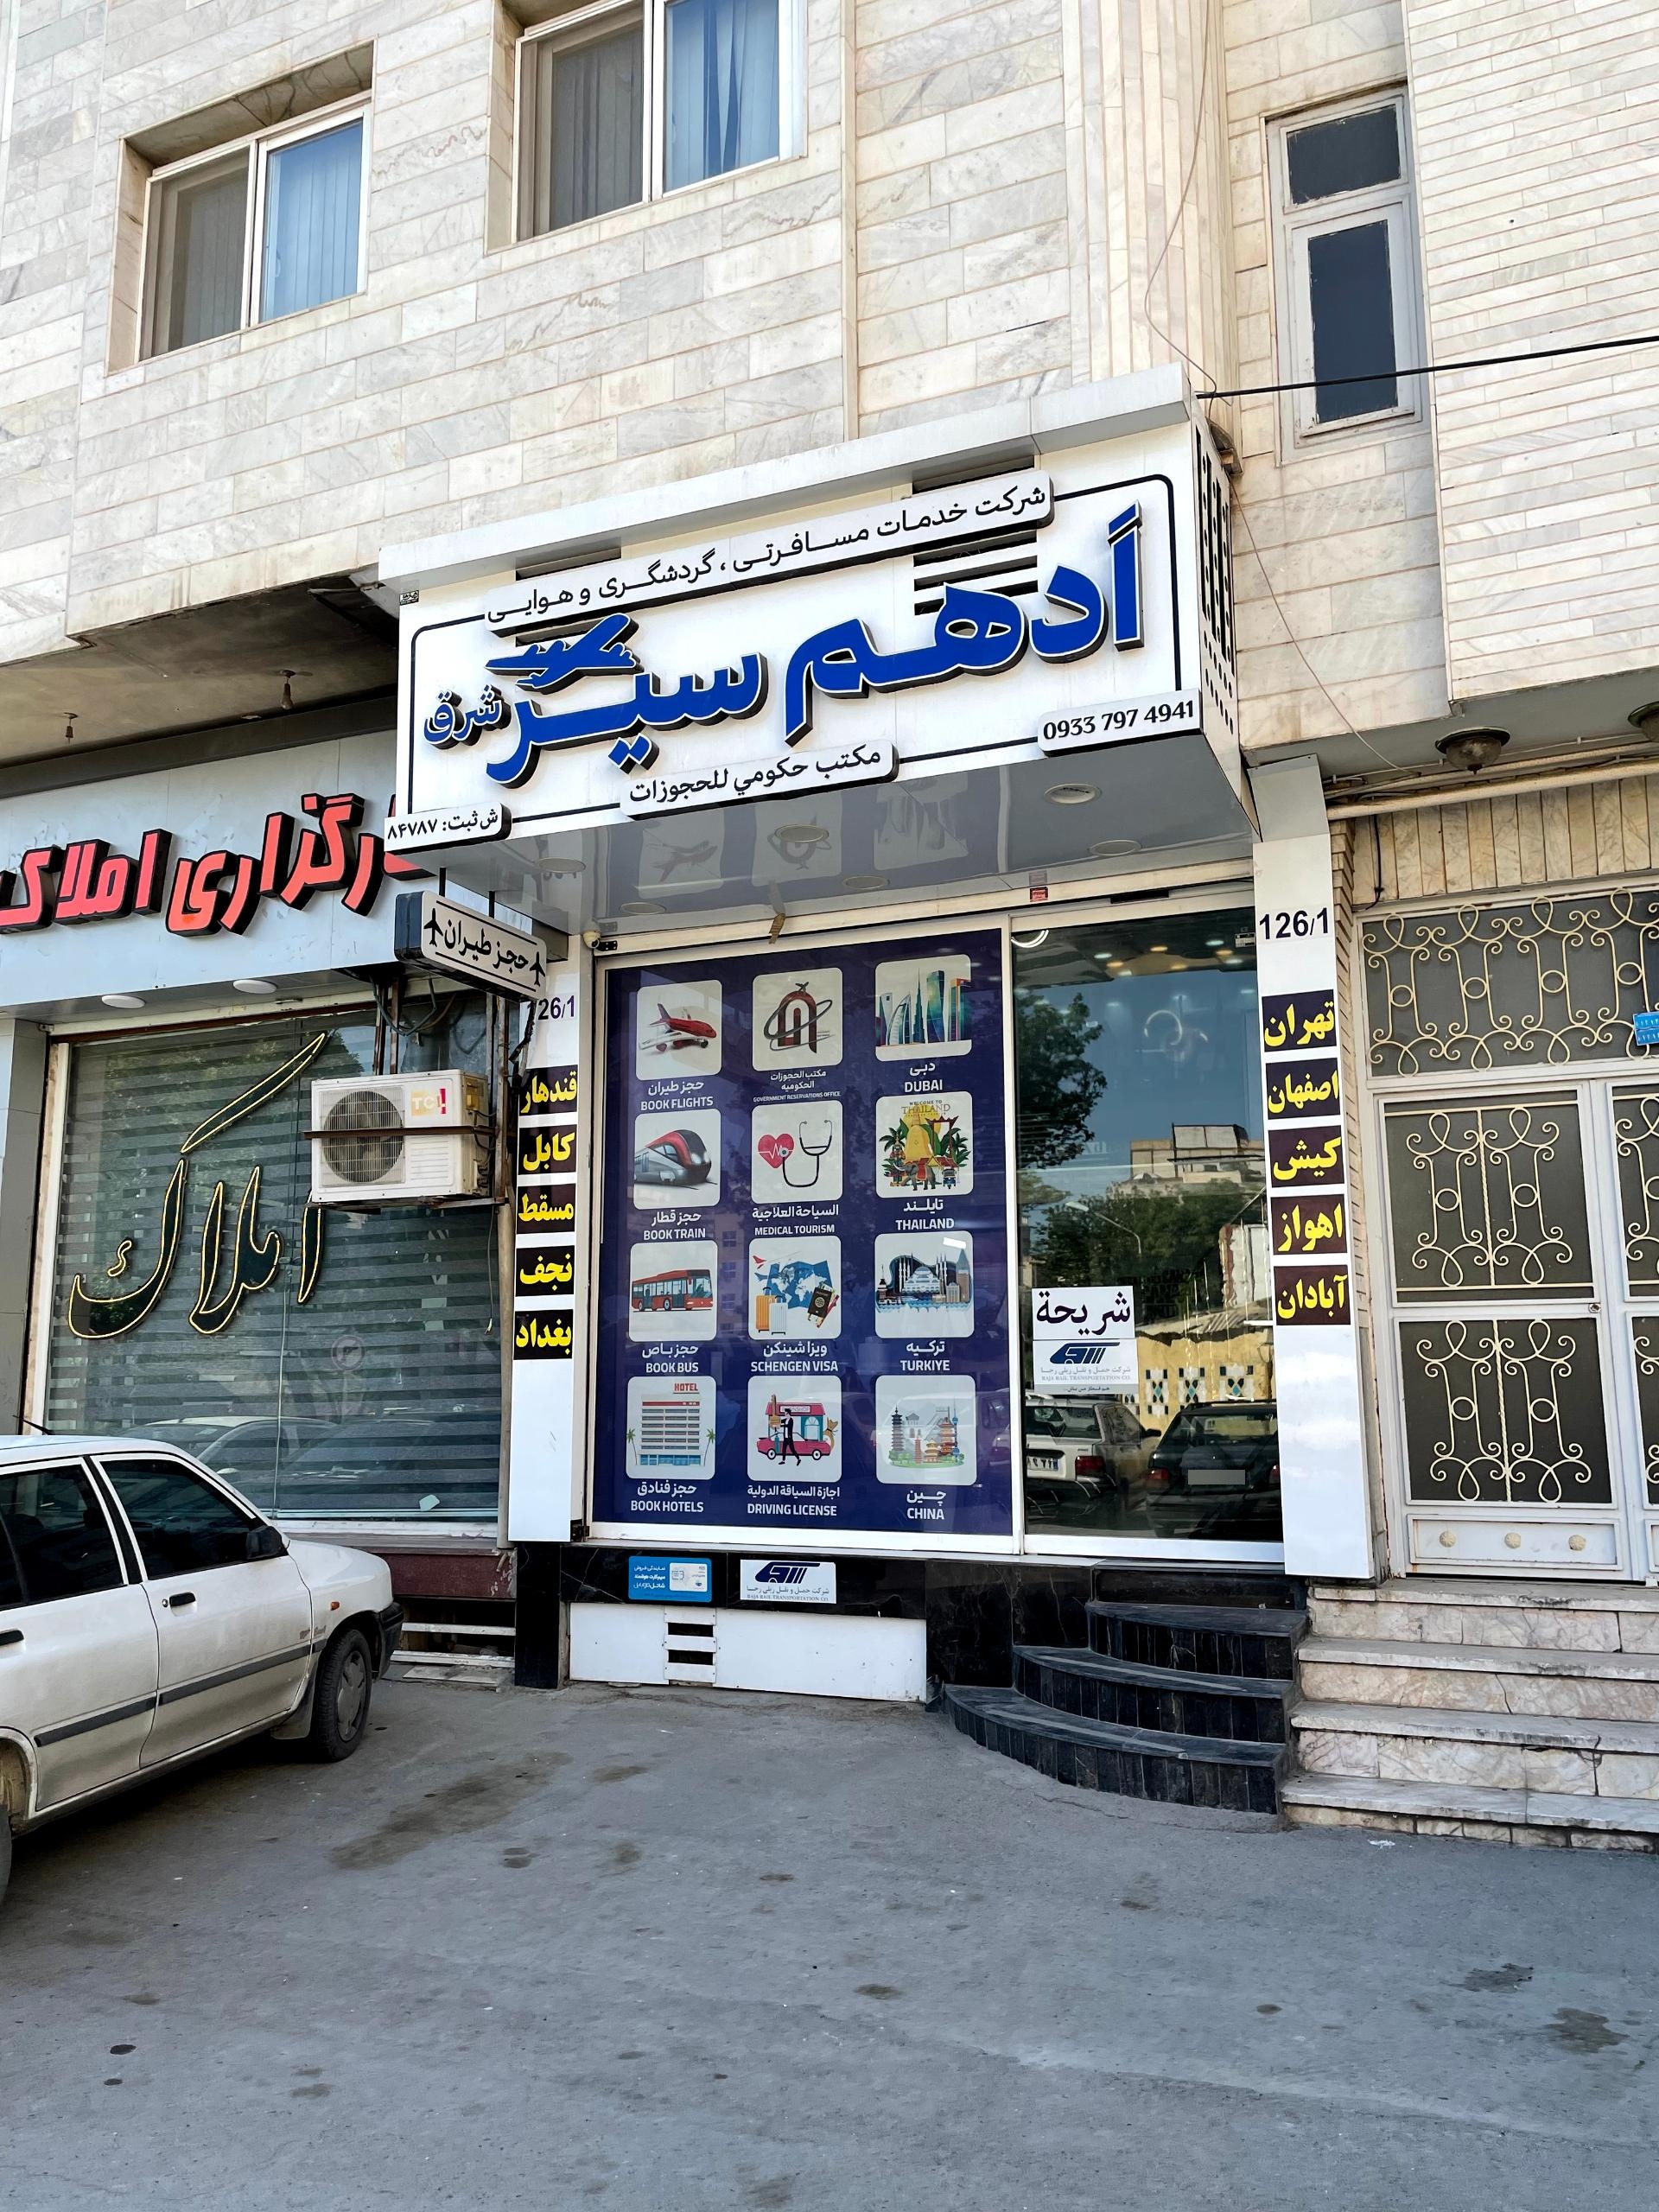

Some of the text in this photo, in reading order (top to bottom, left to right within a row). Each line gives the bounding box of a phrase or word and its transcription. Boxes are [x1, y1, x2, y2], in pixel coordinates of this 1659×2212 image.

[976, 485, 1046, 518] شرکت
[876, 502, 968, 537] خدمات
[598, 547, 716, 598] گردشگری
[578, 588, 591, 604] و
[486, 588, 574, 623] هوایی
[423, 684, 512, 750] شرق
[1043, 700, 1195, 741] 0933 797 4941
[629, 768, 728, 804] للحجوزات
[0, 828, 173, 935] املاک
[1259, 907, 1329, 940] 126/1
[493, 940, 529, 975] حجز
[1263, 1001, 1335, 1047] تهران
[520, 1071, 578, 1113] قندهار
[678, 1079, 704, 1096] حجز
[904, 1079, 944, 1093] DUBAI
[1268, 1070, 1339, 1114] اصفهان
[640, 1096, 714, 1111] BOOK FLIGHTS
[753, 1094, 787, 1103] GOVERNMENT
[786, 1091, 823, 1100] RESERVATIONS
[901, 1103, 951, 1115] THAILAND
[1273, 1136, 1341, 1181] کیش
[518, 1193, 574, 1222] مسقط
[752, 1204, 839, 1222] السياحة العلاجية
[651, 1211, 702, 1227] حجز قطار
[895, 1217, 955, 1231] THAILAND
[1277, 1202, 1343, 1252] اهواز
[643, 1227, 707, 1241] BOOK TRAIN
[754, 1224, 835, 1236] MEDICAL TOURISM
[519, 1253, 573, 1291] نجف
[1277, 1274, 1348, 1319] آبادان
[516, 1318, 572, 1355] بغداد
[641, 1343, 699, 1359] حجز باص
[645, 1362, 699, 1374] BOOK BUS
[750, 1360, 839, 1372] SCHENGEN VISA
[899, 1359, 950, 1371] TURKIYE
[673, 1382, 699, 1392] HOTEL
[637, 1481, 697, 1497] حجز فنادق
[630, 1499, 704, 1513] BOOK HOTELS
[747, 1503, 837, 1516] DRIVING LICENSE
[906, 1506, 944, 1521] CHINA
